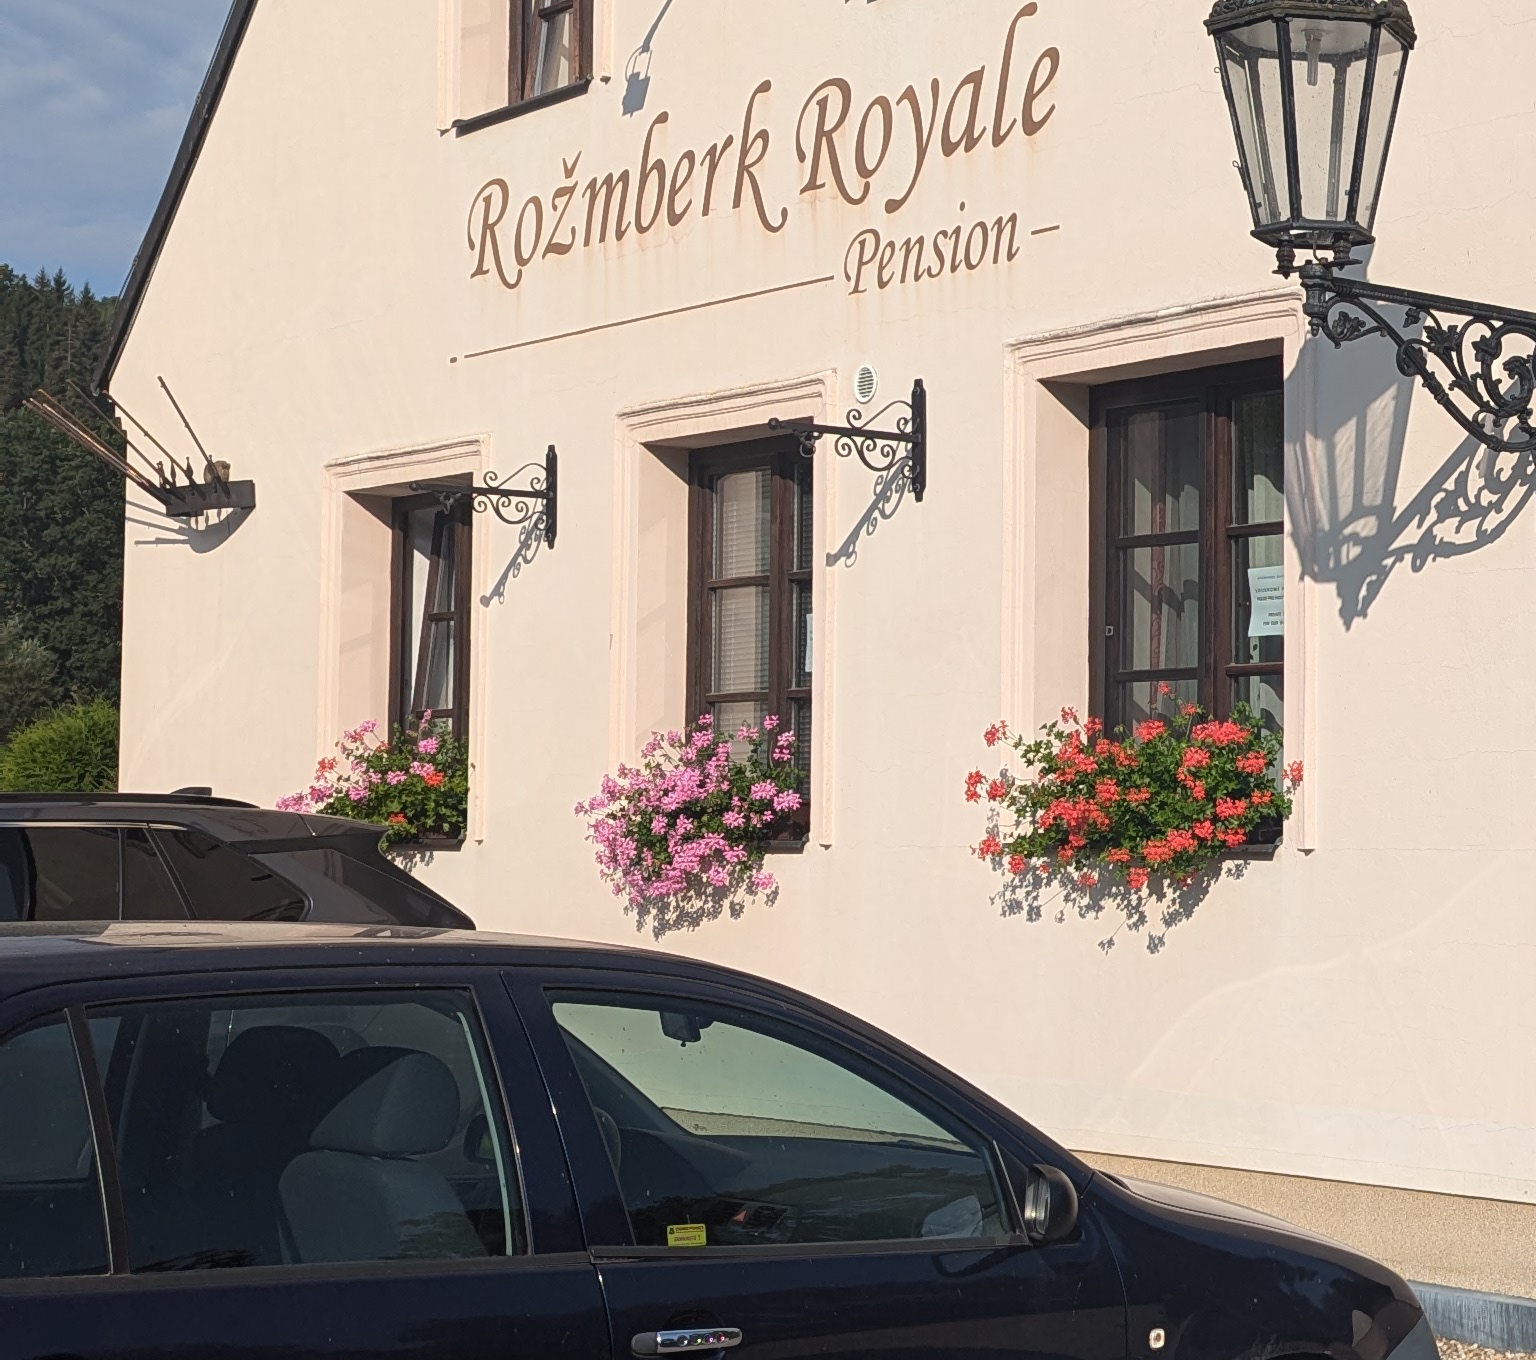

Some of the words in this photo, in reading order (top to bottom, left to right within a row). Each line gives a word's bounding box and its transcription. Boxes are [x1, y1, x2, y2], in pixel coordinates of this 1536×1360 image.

[467, 80, 789, 290] Rožmberk
[796, 1, 1060, 215] Royale
[844, 202, 1021, 296] Pension
